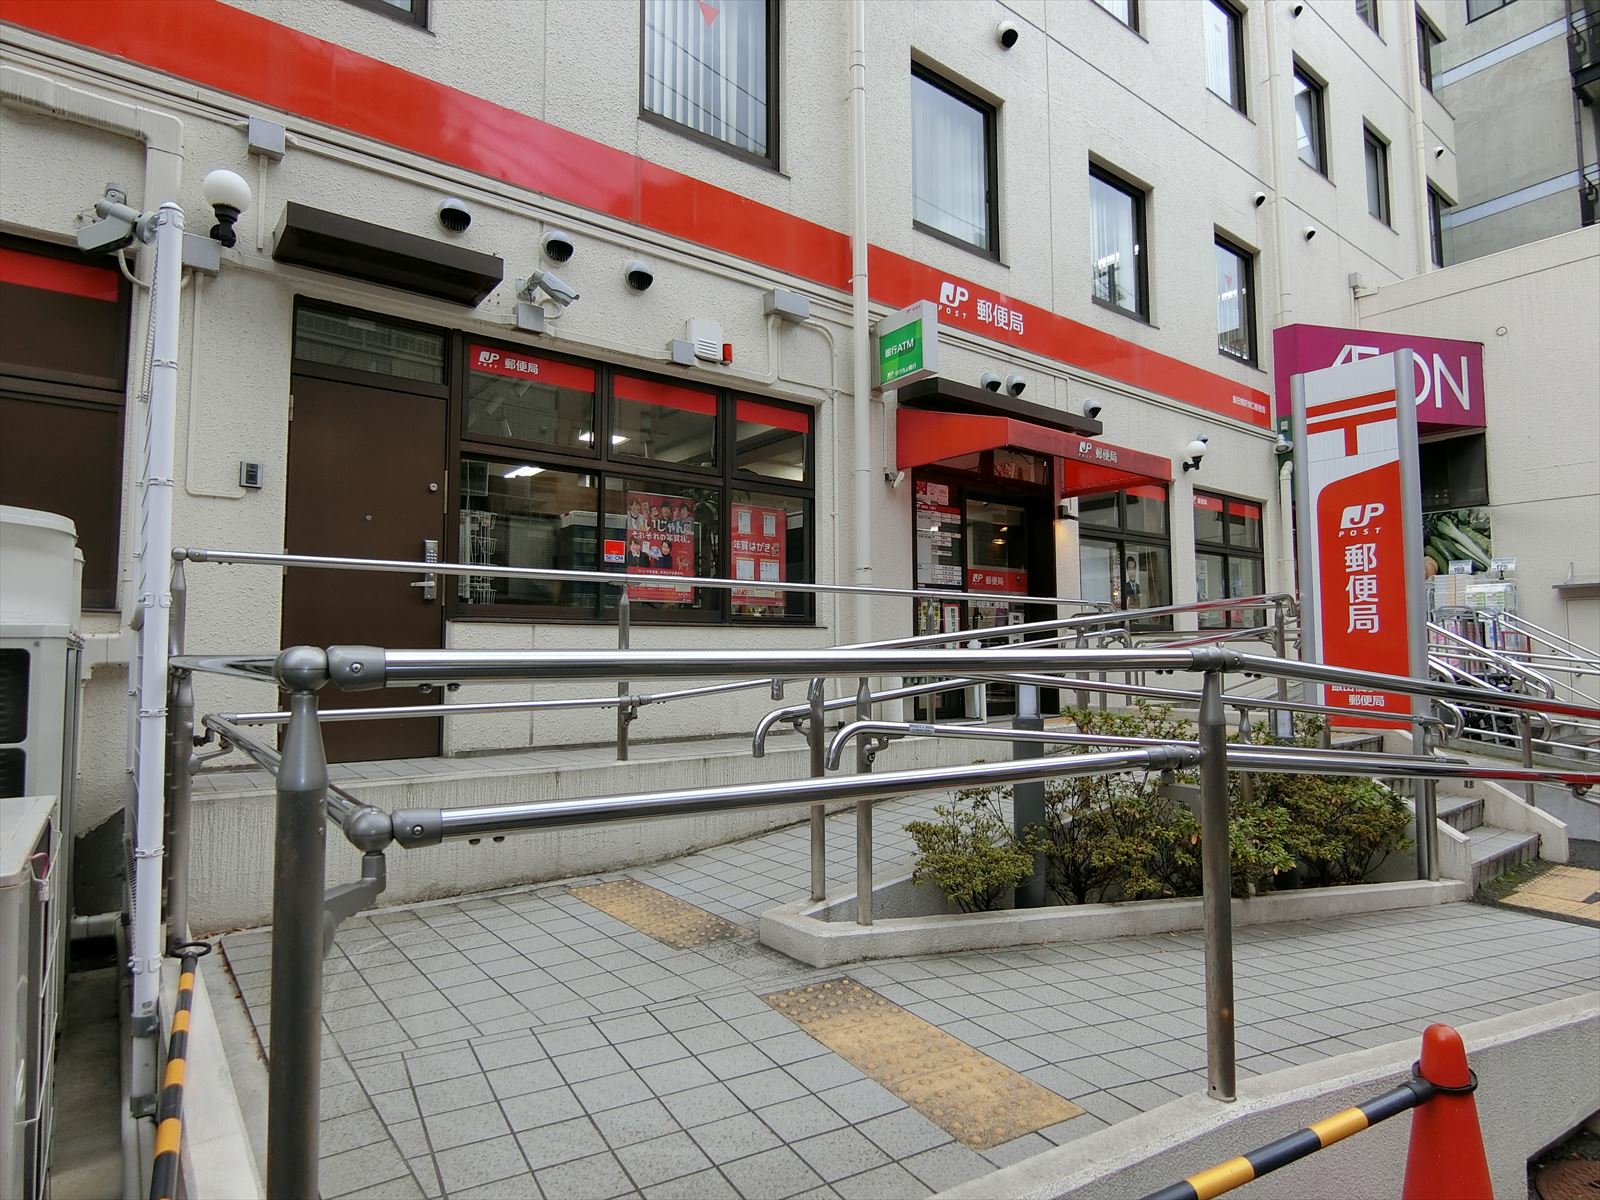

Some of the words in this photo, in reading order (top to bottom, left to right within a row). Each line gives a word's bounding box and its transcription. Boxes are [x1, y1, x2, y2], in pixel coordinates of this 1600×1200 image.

[938, 305, 967, 319] POST
[940, 282, 968, 307] JP
[977, 299, 1023, 335] 郵便局
[885, 338, 914, 358] 銀行ATM
[505, 358, 538, 374] 郵便局
[1096, 448, 1117, 463] 郵便局
[1340, 503, 1384, 529] JP
[1338, 527, 1382, 537] POST
[734, 540, 770, 553] 年賀はがき
[986, 576, 1003, 585] 郵便局
[1345, 543, 1379, 634] 郵便局
[1349, 694, 1384, 706] 郵便局
